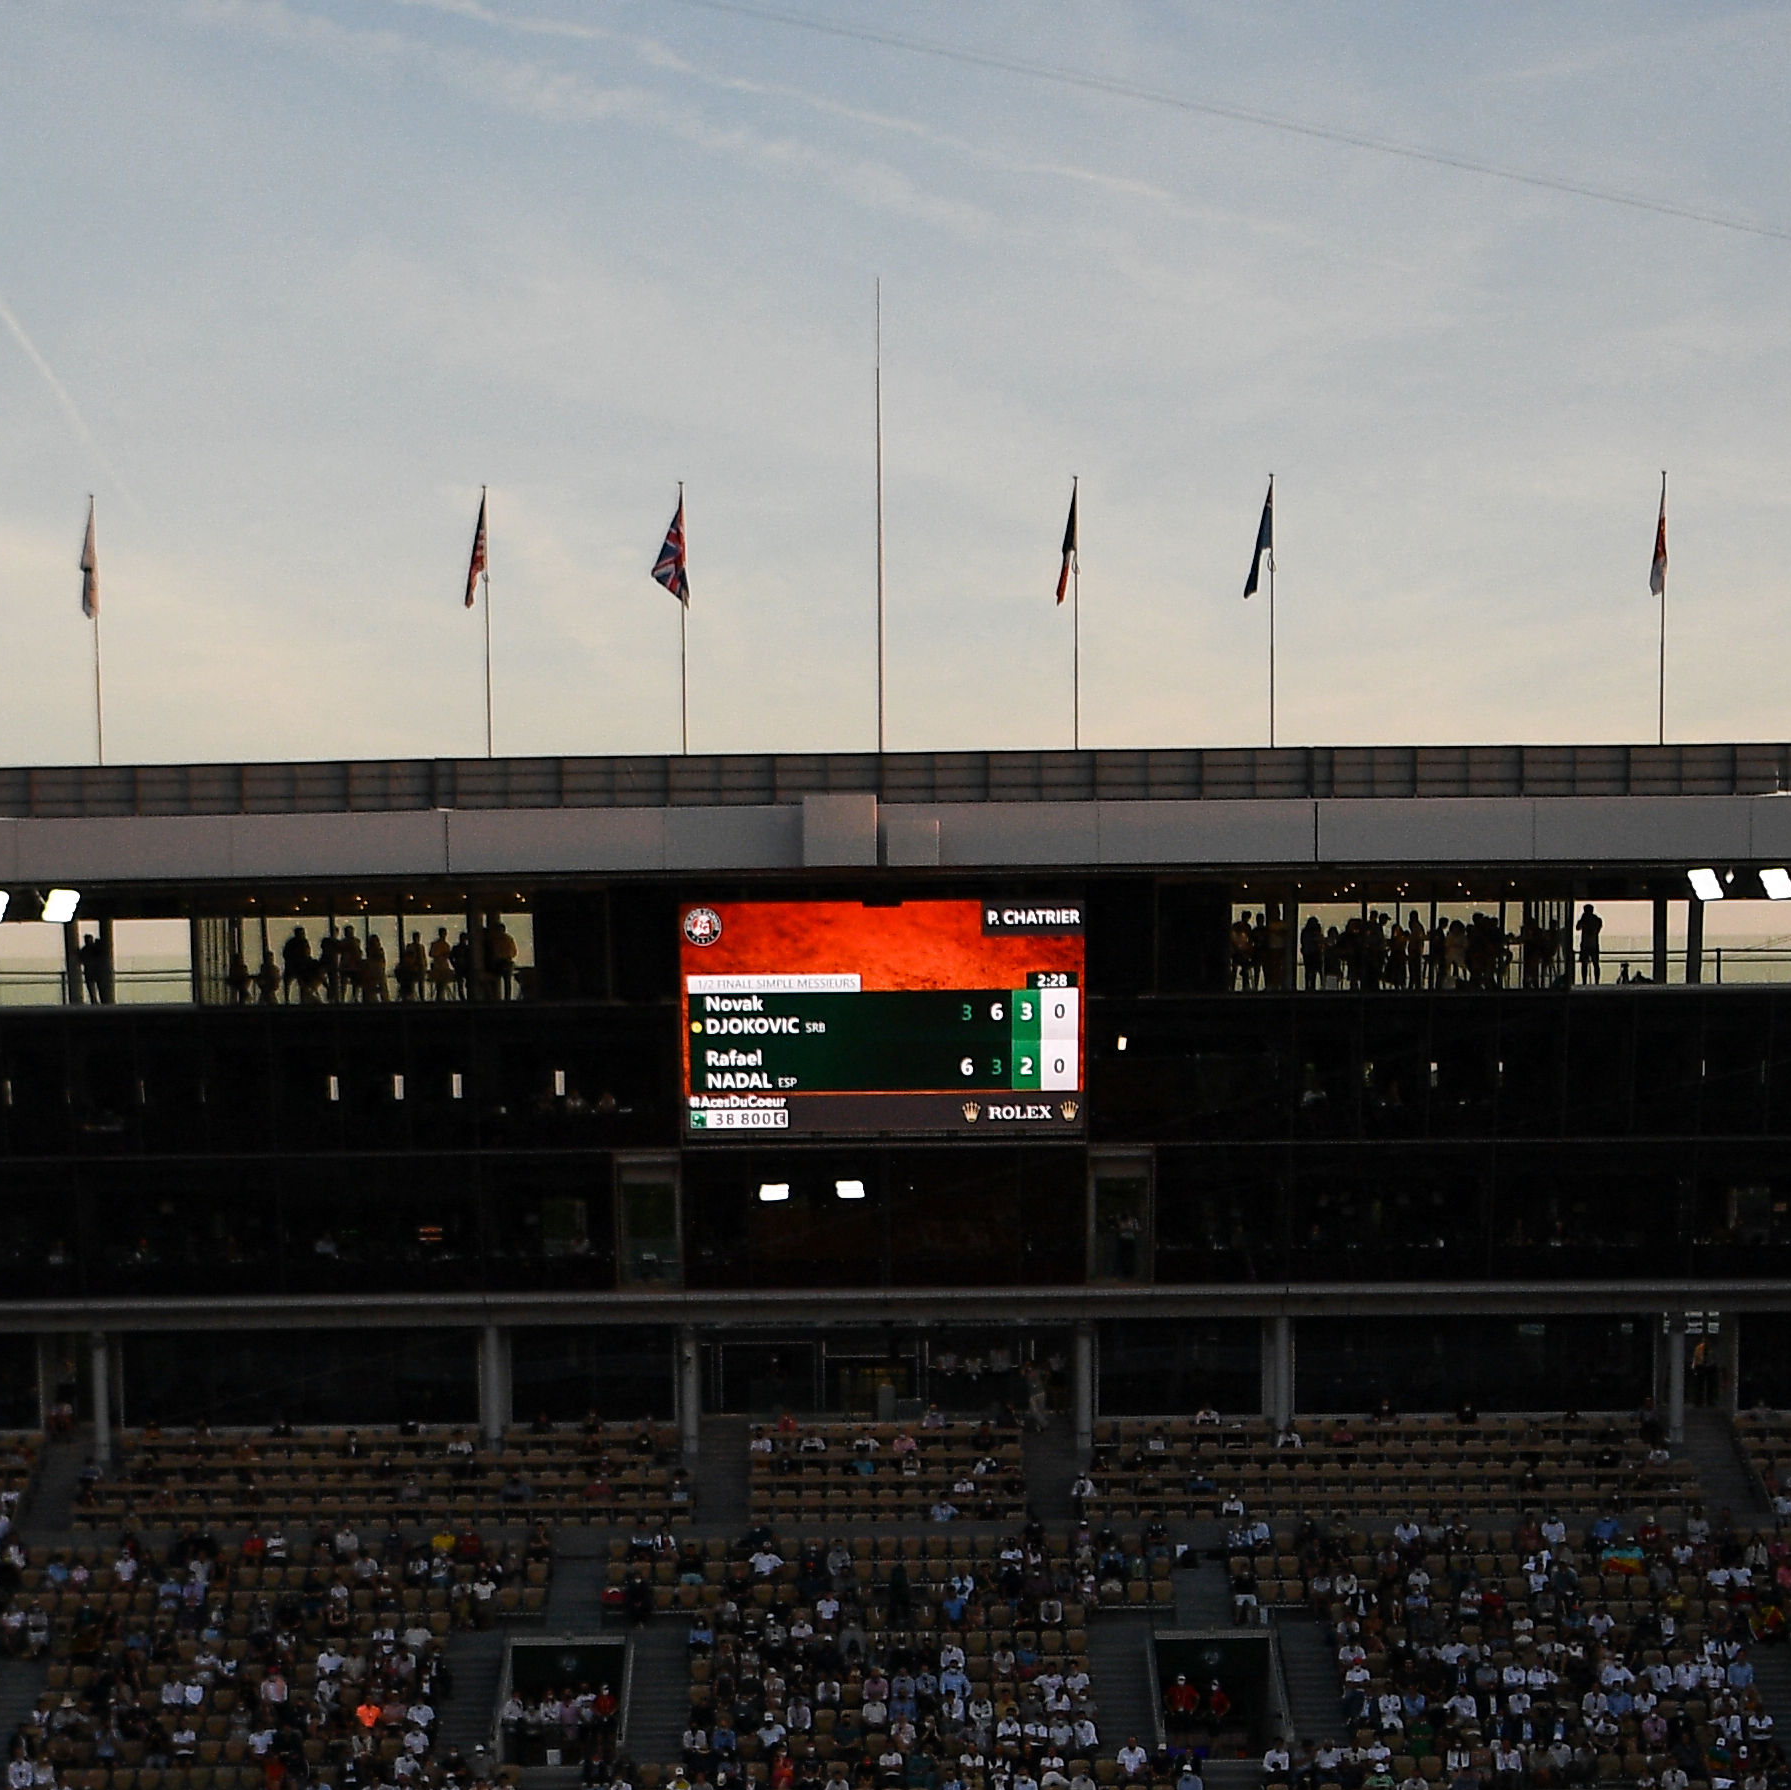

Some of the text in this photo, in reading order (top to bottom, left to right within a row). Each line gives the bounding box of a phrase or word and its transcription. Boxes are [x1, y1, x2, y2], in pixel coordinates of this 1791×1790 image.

[987, 909, 1081, 925] P. CHATRIER
[717, 979, 752, 989] FINALE
[756, 979, 793, 988] SIMPLE
[797, 978, 856, 988] MESSIEURS
[1037, 973, 1068, 987] 2:28
[705, 995, 763, 1012] Novak
[962, 1002, 1065, 1021] 3 6 3 0
[705, 1017, 826, 1034] DJOKOVIC SRB
[706, 1048, 762, 1066] Rafael
[960, 1057, 1065, 1076] 6 3 2 0
[707, 1072, 797, 1089] NADAL ESP
[988, 1105, 1053, 1119] ROLEX
